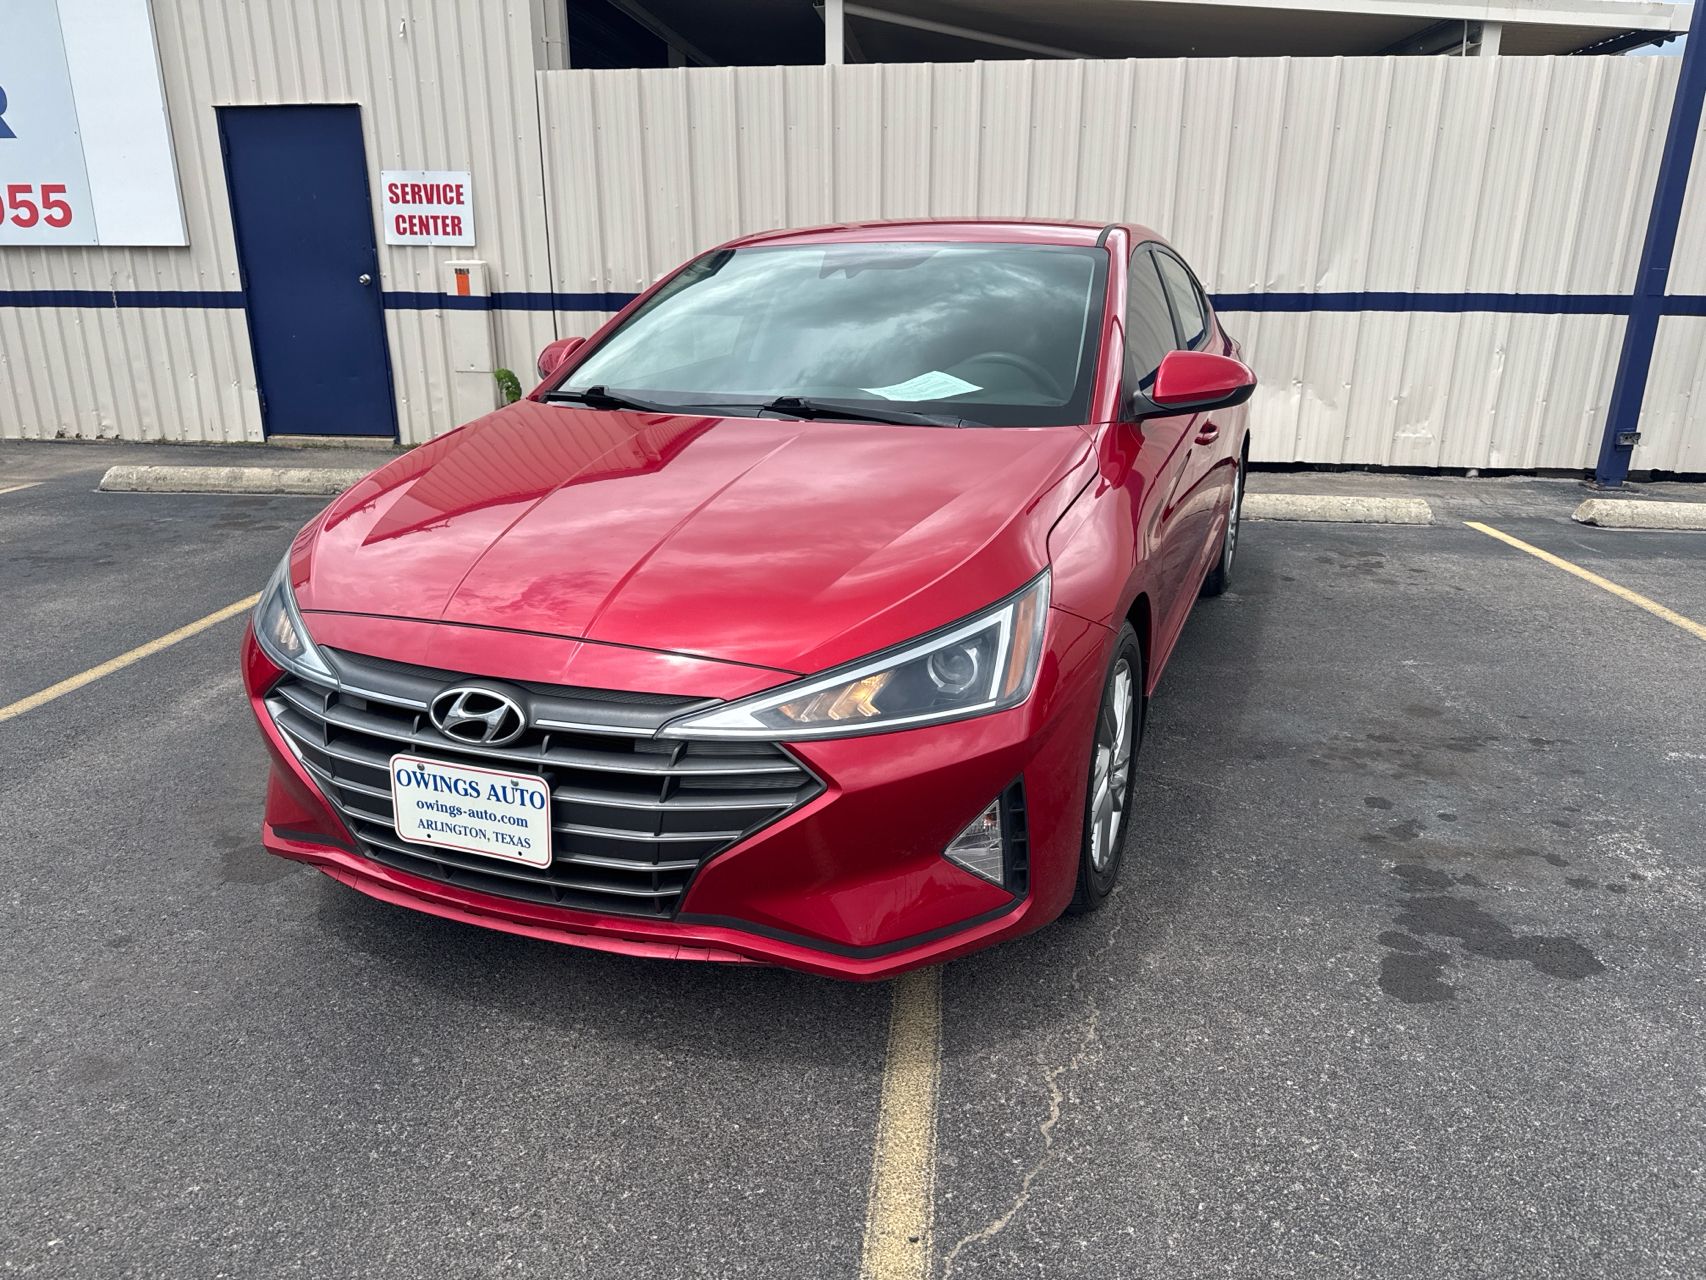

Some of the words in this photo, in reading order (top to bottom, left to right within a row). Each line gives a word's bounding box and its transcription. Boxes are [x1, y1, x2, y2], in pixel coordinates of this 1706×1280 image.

[0, 184, 73, 228] 55
[388, 183, 464, 205] SERVICE
[395, 214, 463, 236] CENTER
[396, 769, 481, 798] OWINGS
[487, 784, 545, 809] AUTO
[416, 800, 528, 828] owings-auto.com
[417, 818, 491, 842] ARLINGTON,
[493, 831, 531, 849] TEXAS
